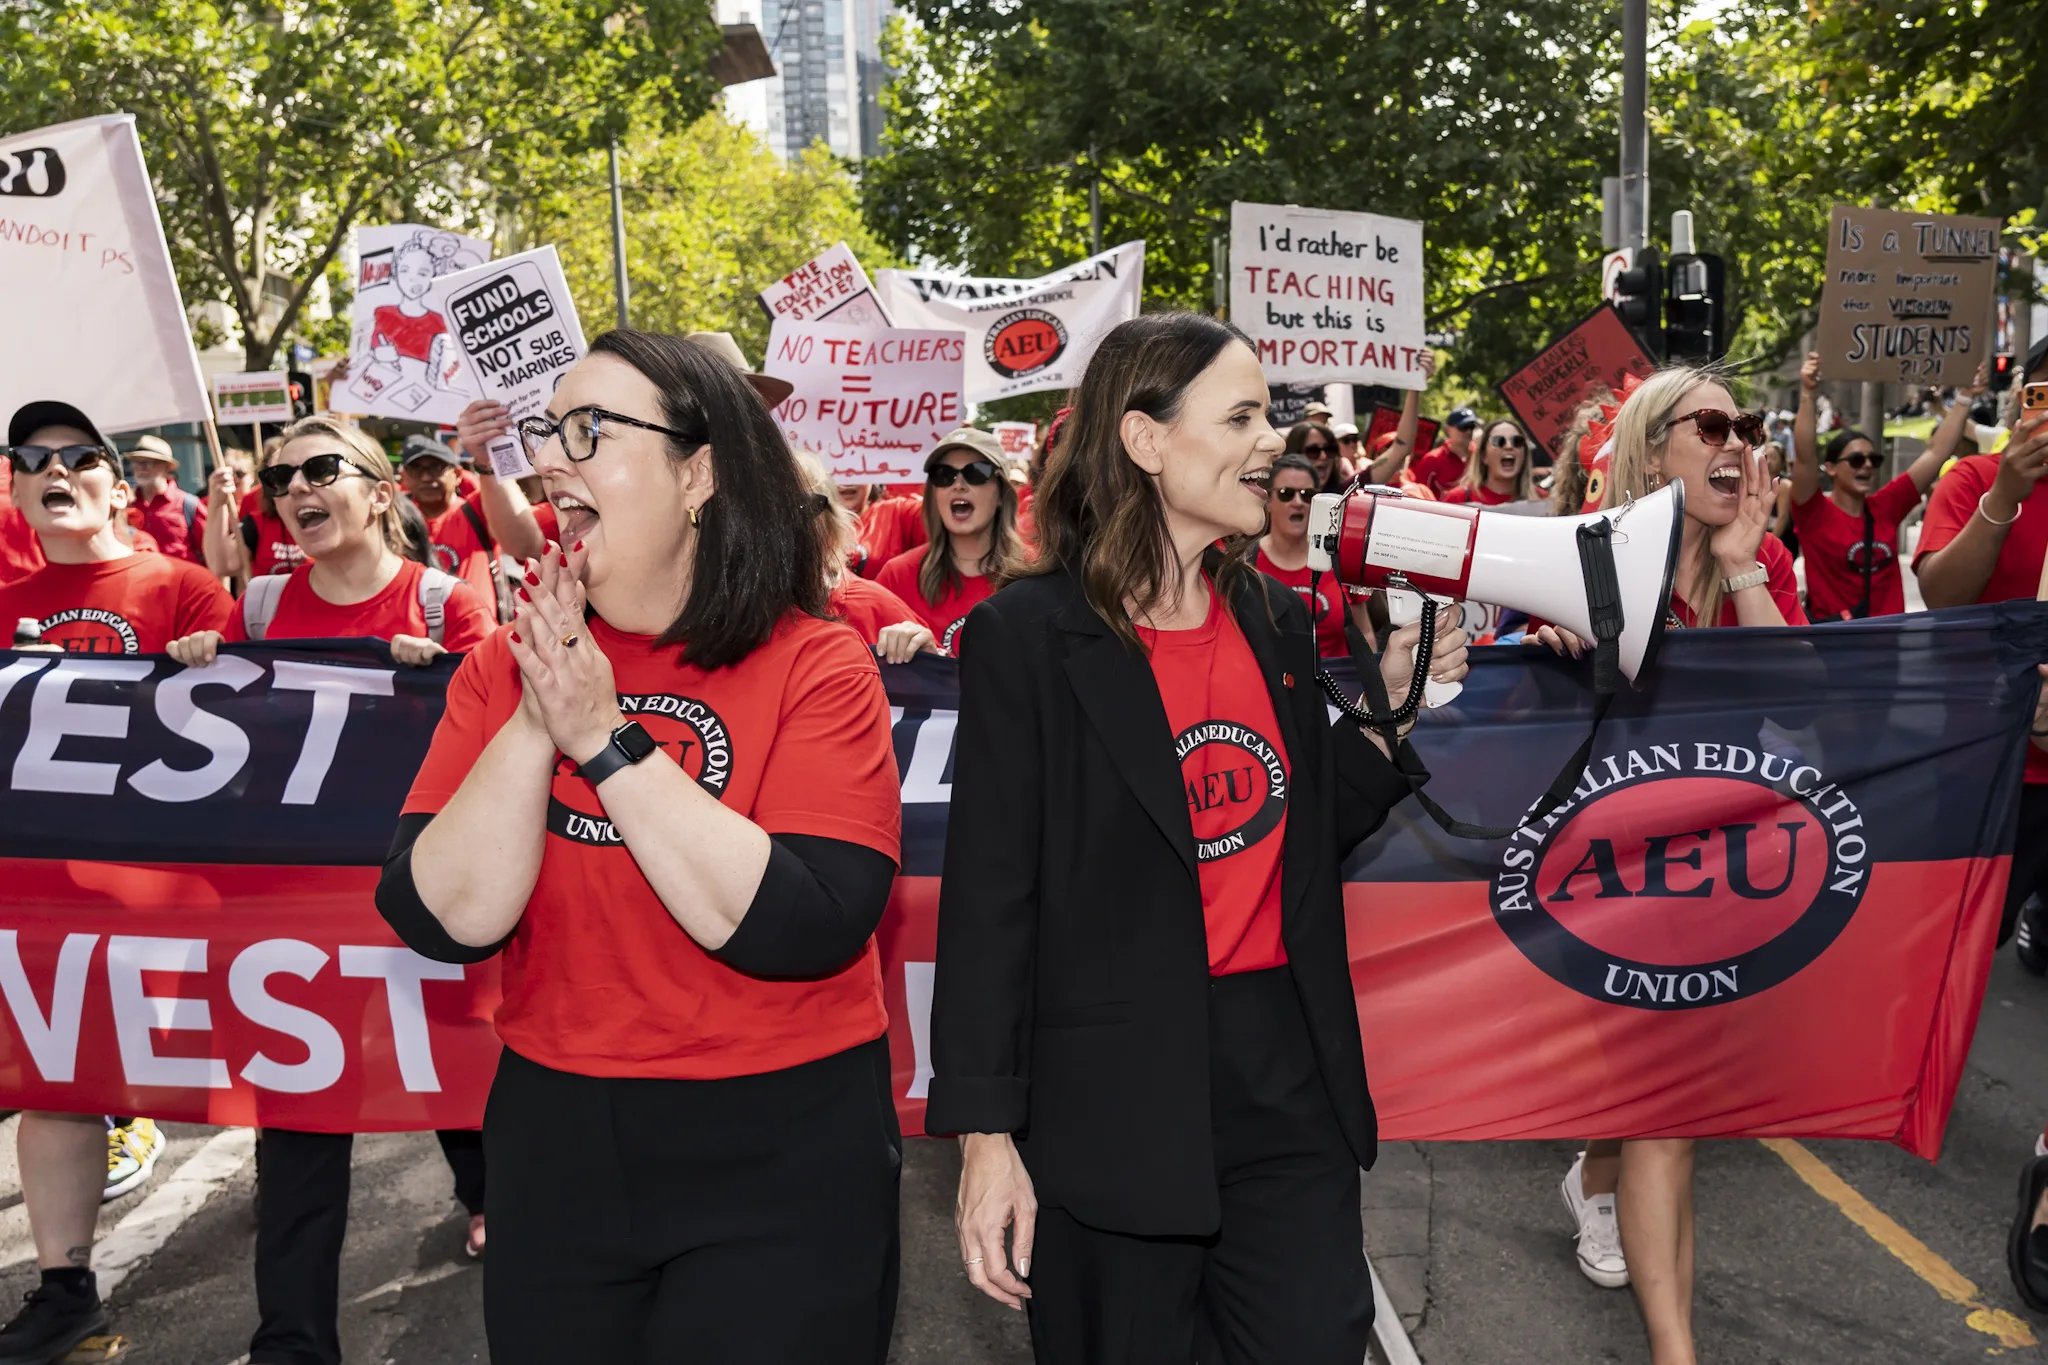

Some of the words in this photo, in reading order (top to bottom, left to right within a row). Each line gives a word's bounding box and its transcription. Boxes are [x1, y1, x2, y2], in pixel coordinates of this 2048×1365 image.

[1259, 224, 1292, 252] I'd
[1298, 230, 1368, 258] rather
[1376, 235, 1399, 263] be
[1840, 216, 1864, 252] Is
[1882, 230, 1900, 252] a
[1912, 221, 1999, 256] TUNNEL
[774, 259, 852, 314] EDUCATION
[783, 261, 821, 289] THE
[1245, 266, 1394, 306] TEACHING
[454, 281, 519, 327] FUND
[792, 275, 856, 320] STATE?
[1028, 290, 1074, 305] SCHOOL
[1266, 301, 1304, 329] but
[1312, 305, 1352, 330] this
[1366, 308, 1385, 333] is
[462, 294, 551, 351] SCHOOLS
[1846, 323, 1971, 362] STUDENTS
[475, 337, 523, 378] NOT
[529, 330, 565, 356] SUB
[778, 334, 813, 364] NO
[824, 338, 965, 366] TEACHERS
[999, 331, 1053, 359] AEU
[776, 399, 807, 423] NO
[817, 391, 958, 428] FUTURE
[641, 696, 729, 788] EDUCATION
[1208, 724, 1285, 799] EDUCATION
[1186, 766, 1254, 813] AEU
[1694, 742, 1867, 897] EDUCATION
[1198, 832, 1245, 859] UNION
[1547, 821, 1806, 902] AEU
[1604, 963, 1738, 1003] UNION
